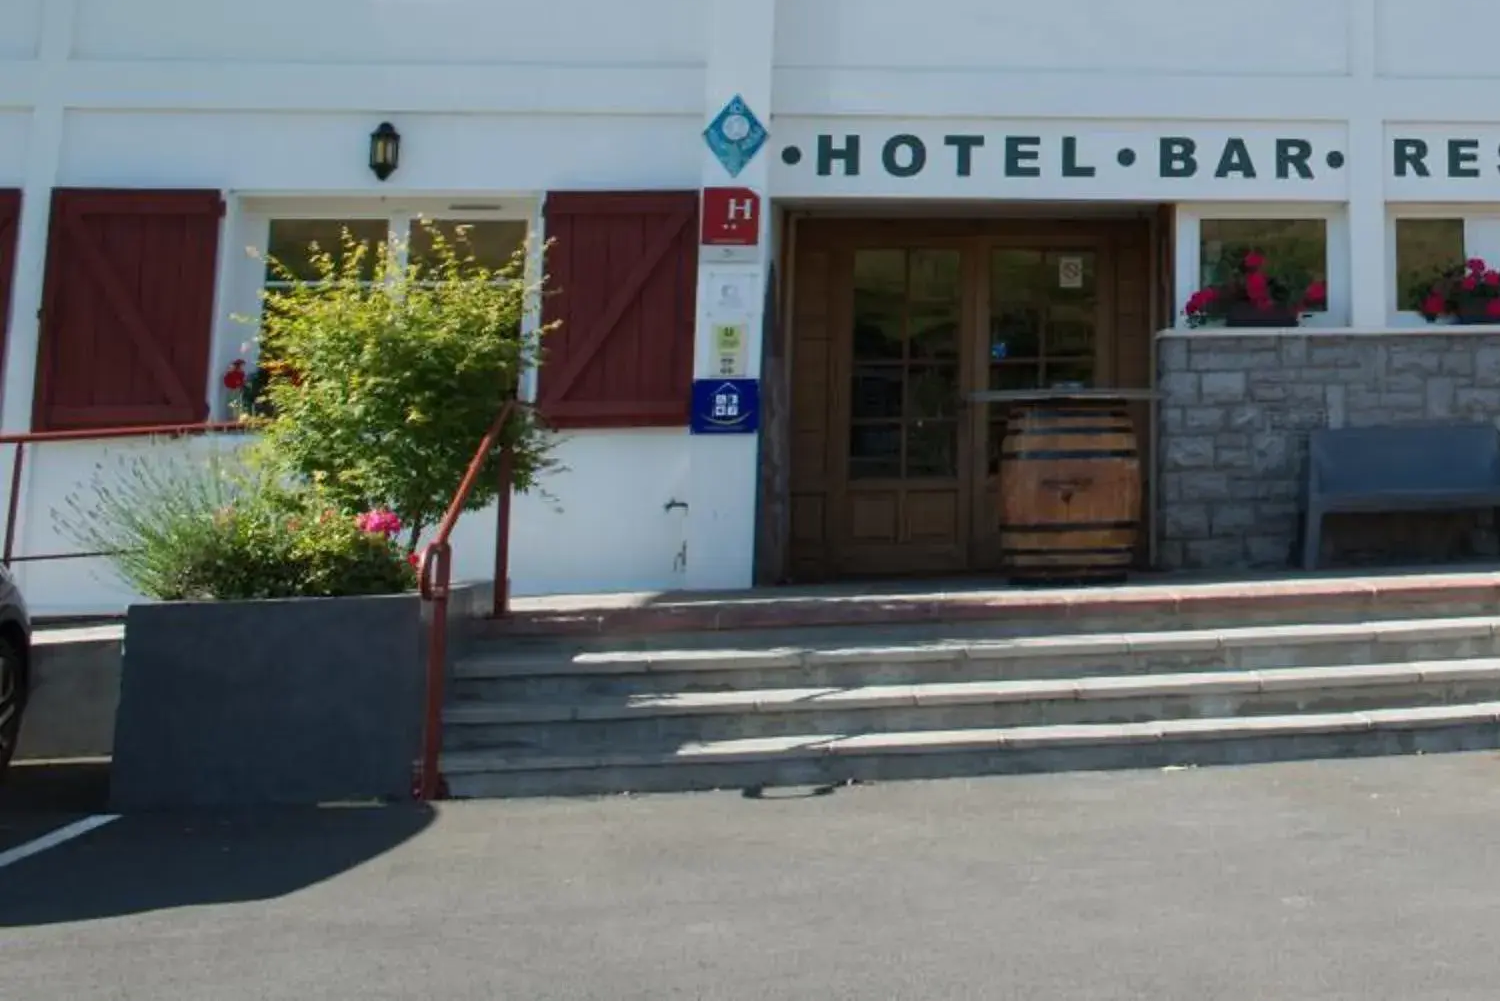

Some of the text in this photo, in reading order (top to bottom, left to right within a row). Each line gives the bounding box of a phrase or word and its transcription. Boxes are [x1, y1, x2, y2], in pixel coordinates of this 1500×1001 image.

[815, 133, 1097, 179] HOTEL
[1158, 136, 1315, 180] BAR
[727, 198, 753, 221] H
